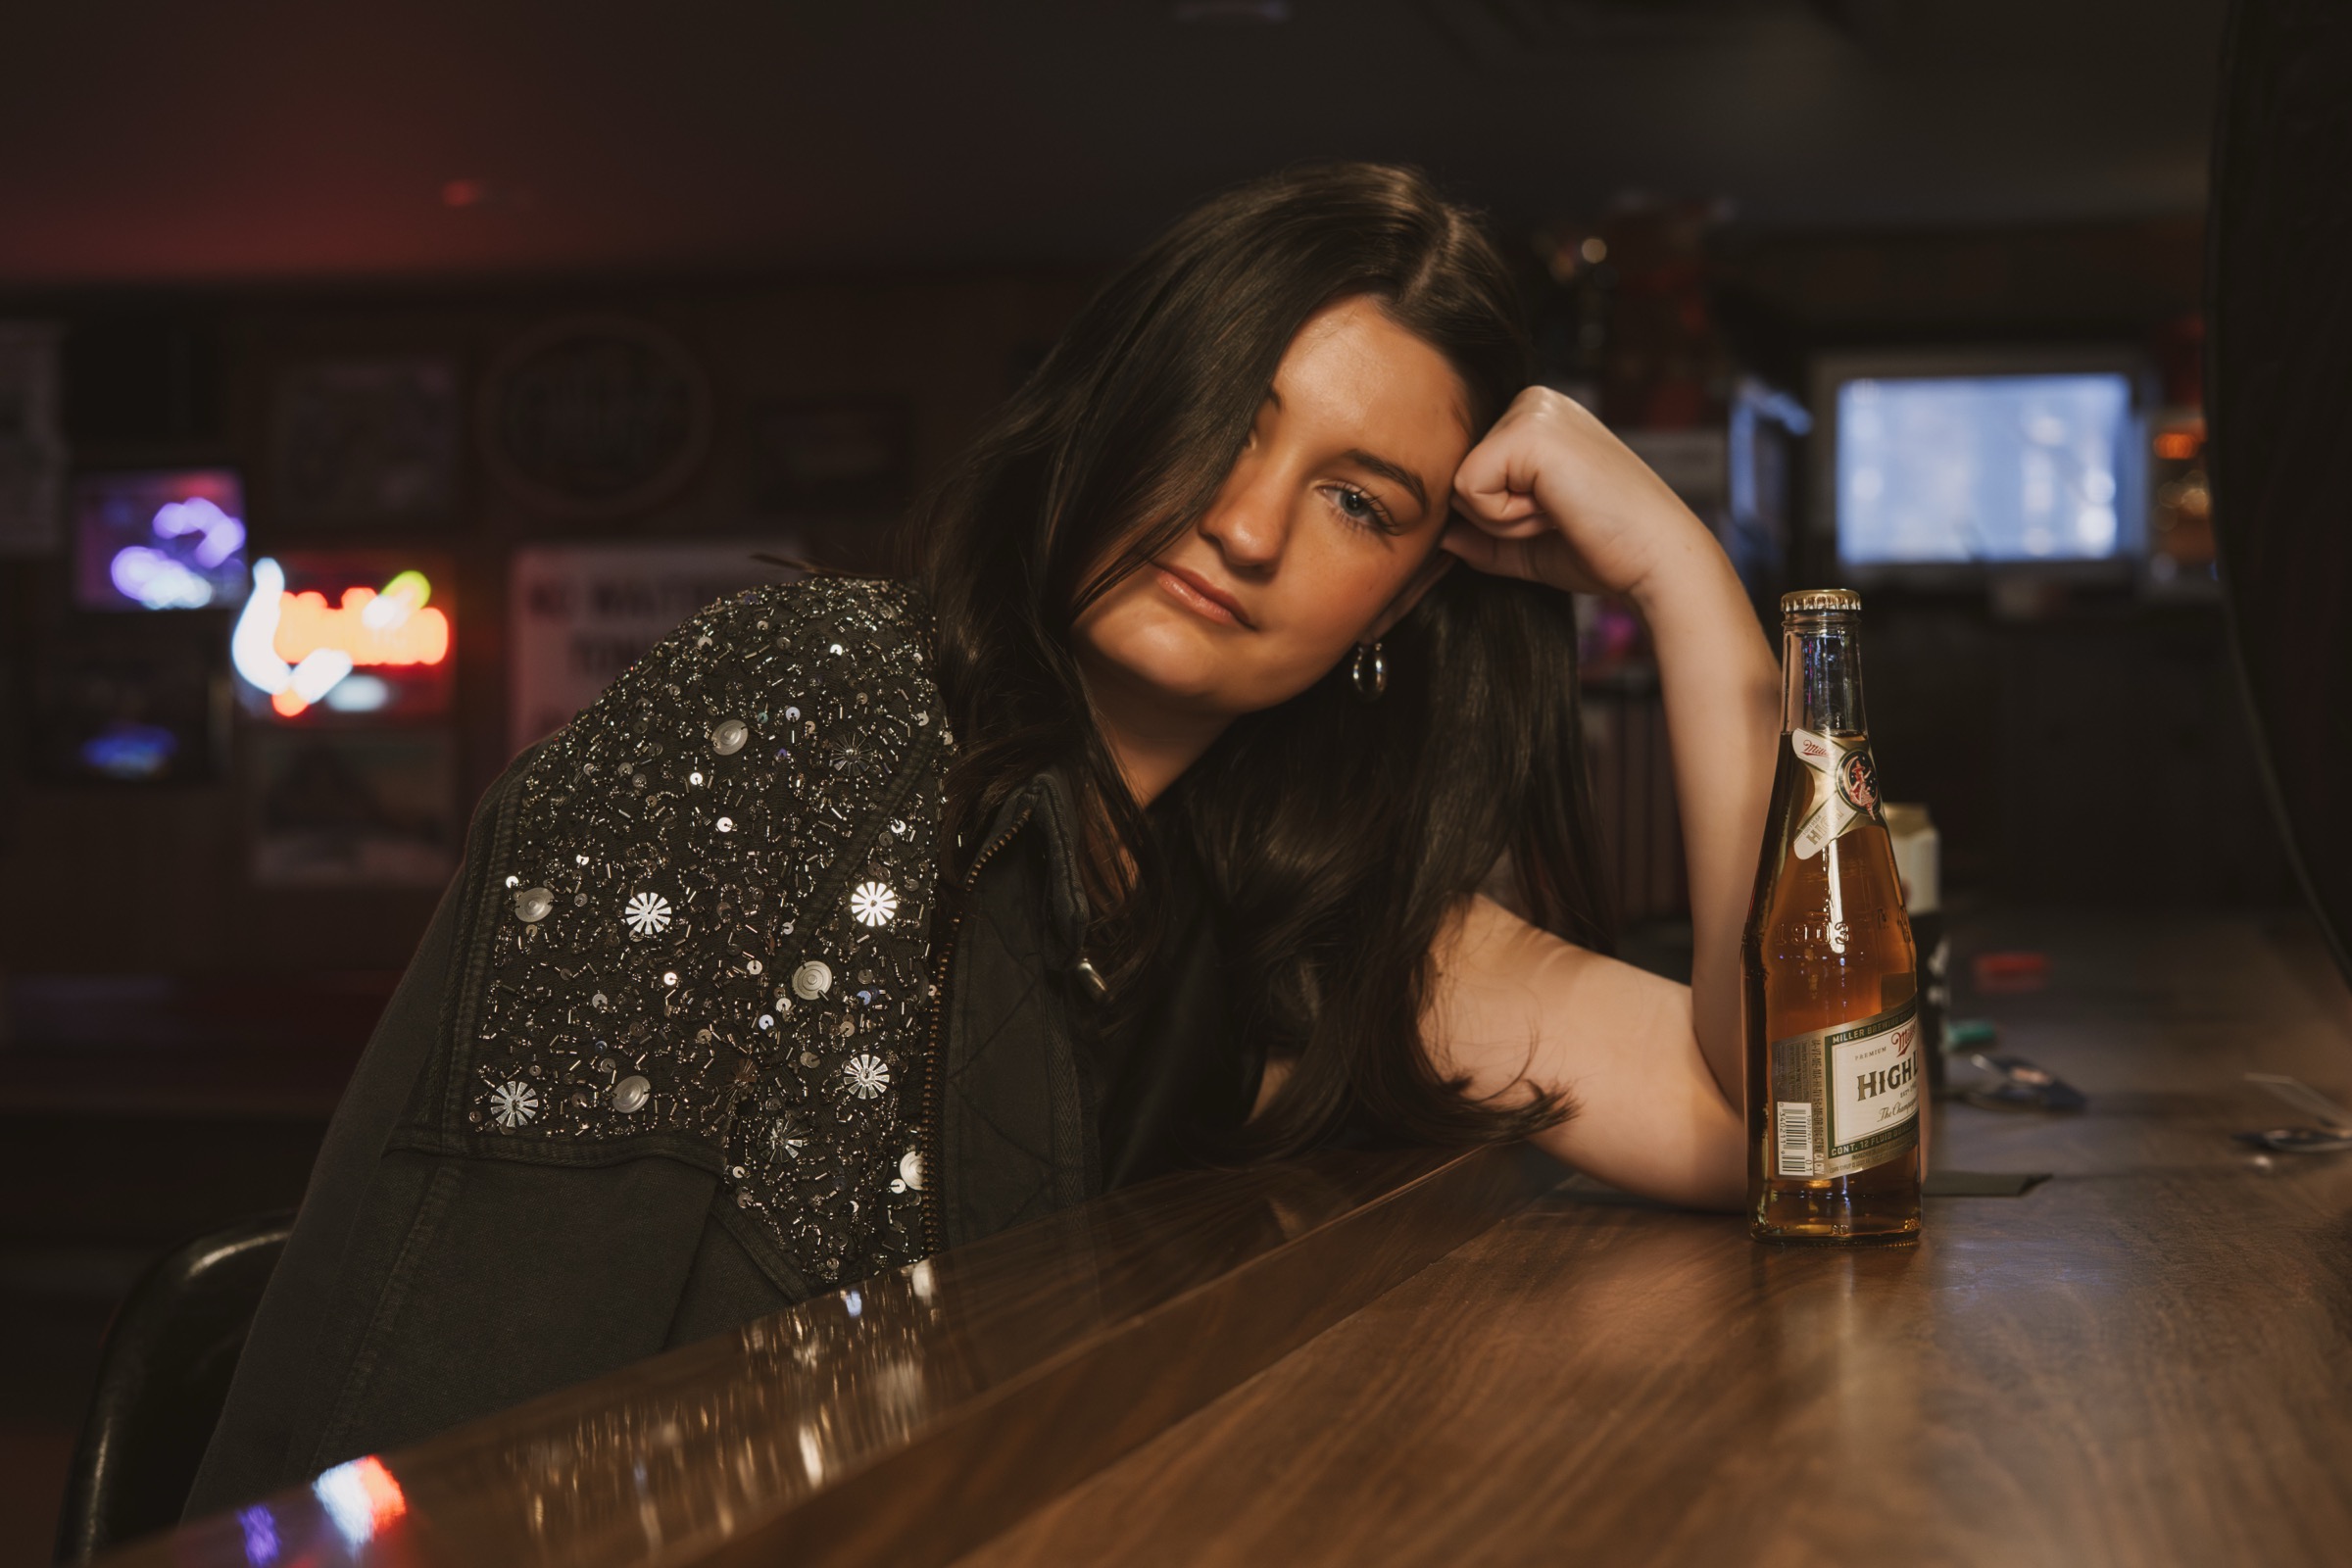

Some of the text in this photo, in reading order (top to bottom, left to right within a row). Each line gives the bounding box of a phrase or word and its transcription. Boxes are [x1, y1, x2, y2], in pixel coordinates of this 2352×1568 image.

[1802, 739, 1830, 756] Mill
[1832, 1027, 1865, 1044] MILLER
[1854, 1046, 1887, 1061] PREMIUM
[1876, 1106, 1891, 1124] The
[1831, 1143, 1858, 1156] CONT.
[1859, 1140, 1869, 1151] 12
[1870, 1132, 1892, 1146] FLUID
